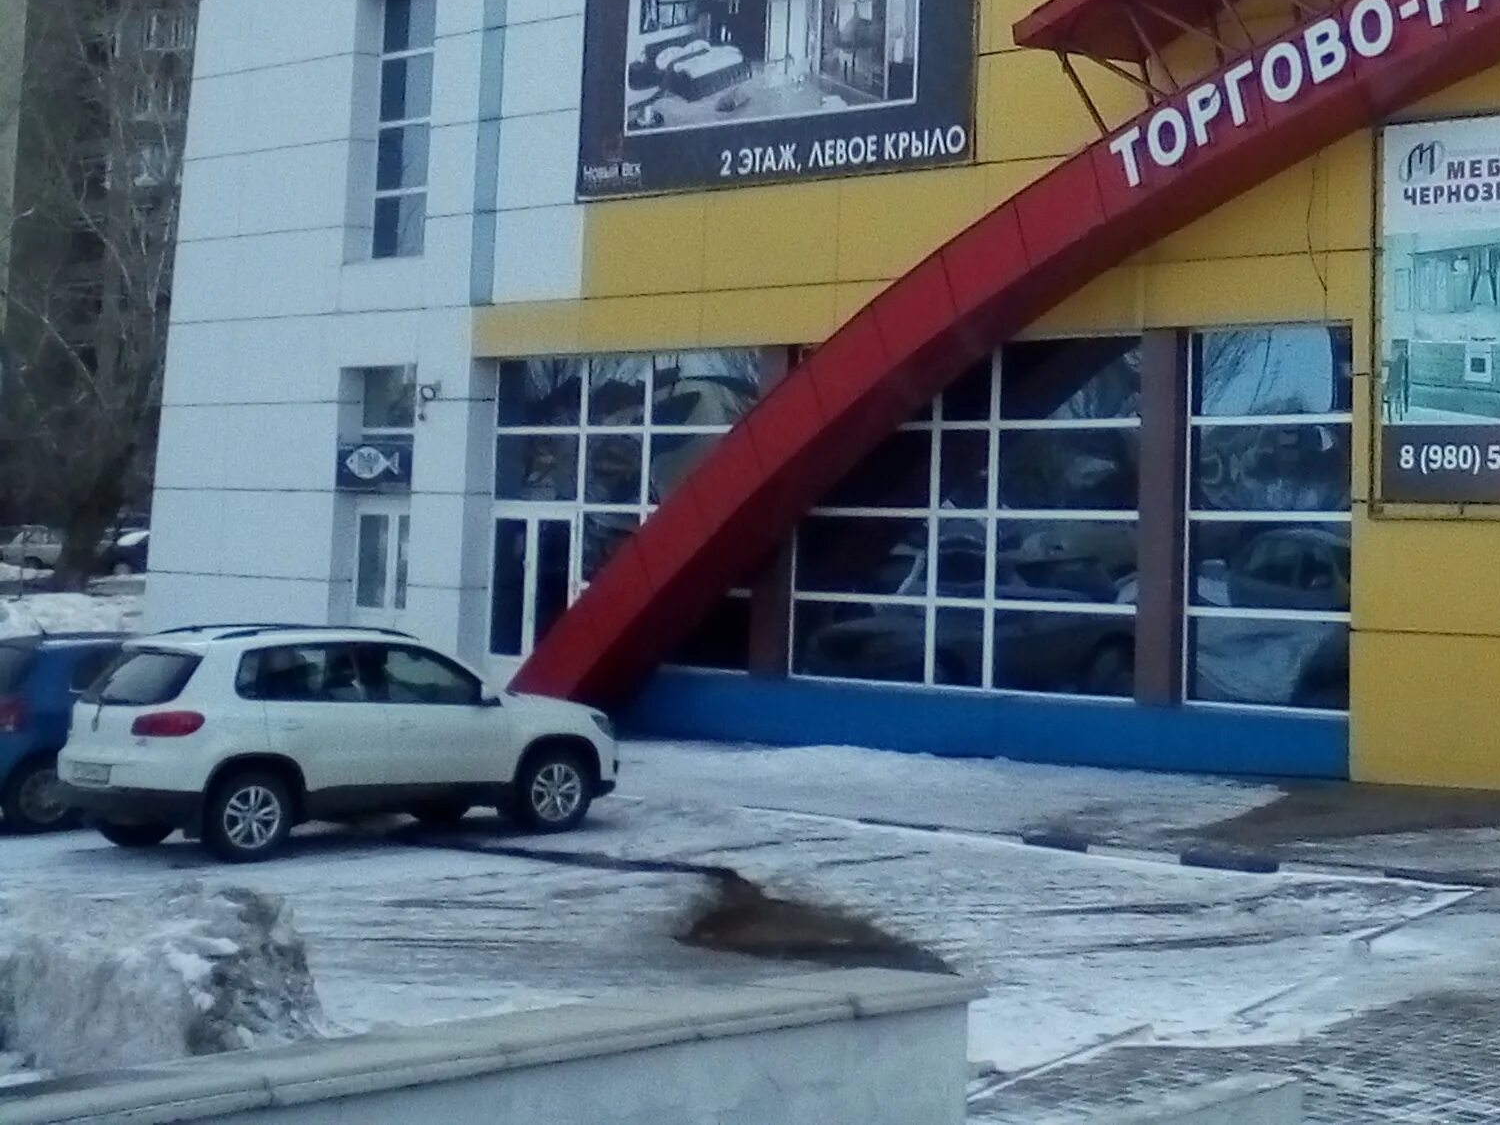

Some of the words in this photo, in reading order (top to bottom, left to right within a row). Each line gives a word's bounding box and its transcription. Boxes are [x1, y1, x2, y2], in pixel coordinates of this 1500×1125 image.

[721, 151, 732, 176] 2
[809, 135, 877, 168] ЛЕВОЕ
[884, 124, 965, 161] КРЫЛО
[1400, 446, 1414, 470] 8
[1420, 444, 1481, 474] (980)
